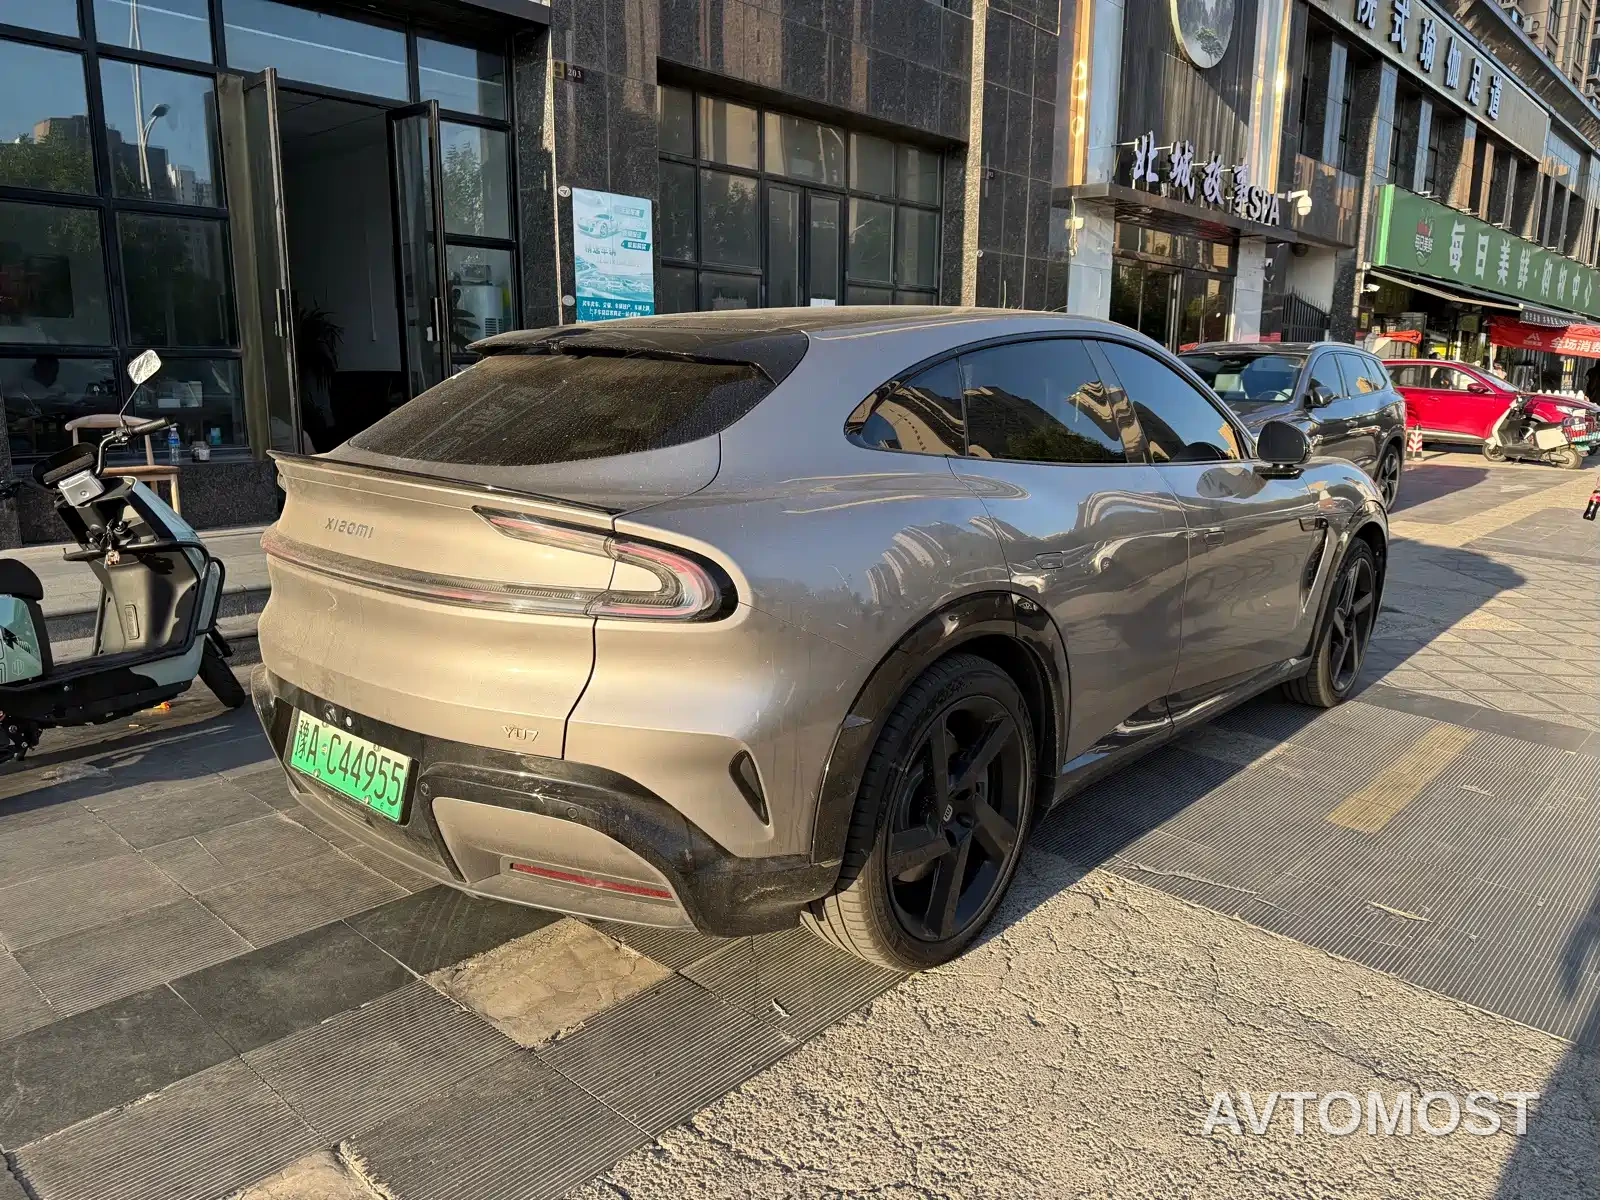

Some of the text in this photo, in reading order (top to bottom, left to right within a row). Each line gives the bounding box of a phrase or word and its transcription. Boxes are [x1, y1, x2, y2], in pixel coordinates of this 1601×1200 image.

[567, 68, 582, 79] 203
[502, 725, 539, 743] YU7
[326, 733, 404, 807] C44955
